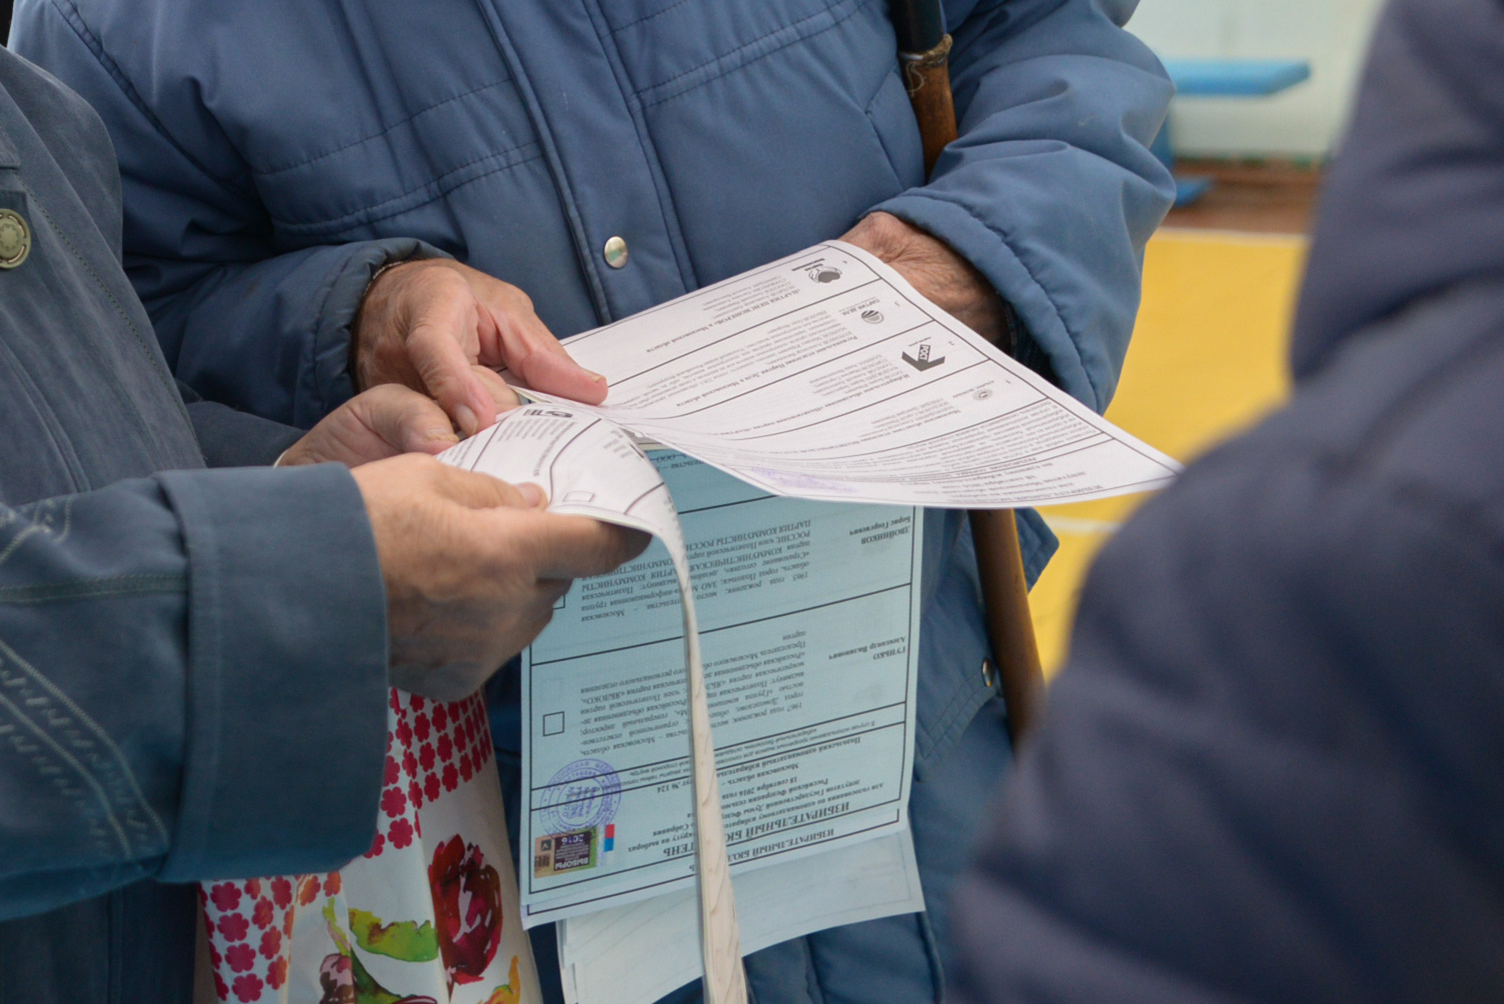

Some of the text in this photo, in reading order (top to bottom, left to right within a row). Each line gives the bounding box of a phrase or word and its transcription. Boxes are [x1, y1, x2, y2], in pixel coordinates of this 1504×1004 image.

[857, 298, 879, 309] ПАРТИЯ
[841, 307, 856, 316] ДЕЛА
[914, 343, 933, 362] РОСТ
[778, 519, 810, 532] ПАРТИЯ
[849, 514, 910, 536] Борис Георгиевич
[715, 525, 776, 545] КОММУНИСТЫ
[758, 537, 773, 546] член
[775, 529, 810, 543] РОССИИ;
[861, 526, 910, 544] ДВОЙНИКОВ
[705, 540, 756, 558] Политической
[786, 539, 809, 550] партия
[689, 546, 782, 571] КОММУНИСТИЧЕСКАЯ
[762, 549, 809, 566] «Страхование
[723, 561, 756, 573] сегодня»,
[758, 565, 778, 576] город
[781, 560, 809, 572] область,
[581, 573, 645, 591] КОММУНИСТЫ
[640, 576, 676, 590] выдвинут:
[720, 571, 756, 585] Подольск;
[769, 576, 784, 585] года
[792, 571, 808, 581] 1965
[700, 580, 717, 589] ЗАО
[725, 580, 761, 594] рождения;
[581, 585, 633, 602] Политическая
[696, 590, 716, 600] место
[581, 599, 606, 611] группа
[581, 608, 624, 623] Московская
[782, 629, 805, 641] партии
[869, 636, 905, 649] Александр
[763, 651, 804, 667] «Российская
[872, 646, 905, 660] ГУНЬКО
[580, 639, 805, 694] Председатель Московского регионального отделения
[713, 660, 761, 677] объединенная
[580, 660, 804, 715] мократическая партия член Политической партии
[627, 683, 650, 695] партия
[720, 679, 766, 696] Политическая
[745, 687, 772, 700] «Группа
[778, 681, 803, 692] ностью
[580, 689, 624, 705] «ЯБЛОКО»,
[784, 690, 803, 701] город
[593, 706, 644, 723] объединенная
[622, 711, 667, 728] генеральный
[732, 708, 767, 722] рождения;
[579, 722, 615, 737] директор;
[629, 718, 678, 736] ограниченной
[809, 727, 849, 741] использования
[580, 732, 622, 747] ответствен-
[613, 735, 654, 751] Московская
[818, 736, 860, 753] Подольский
[579, 744, 609, 758] область,
[761, 746, 816, 767] одномандатный
[727, 761, 798, 785] Московская область
[656, 784, 669, 793] 124
[670, 781, 680, 790] №
[738, 787, 754, 796] 2016
[756, 777, 788, 792] сентября
[788, 777, 828, 794] Российской
[721, 791, 737, 800] года
[748, 788, 786, 803] Федерации
[827, 786, 869, 802] голосования
[652, 778, 859, 837] депутатов Государственной Думы Собрания
[758, 800, 815, 820] одномандатному
[745, 801, 849, 839] ИЗБИРАТЕЛЬНЫЙ
[561, 833, 584, 845] 2016
[628, 839, 658, 853] выборах
[752, 827, 833, 857] ИЗБИРАТЕЛЬНЫЙ
[554, 856, 588, 869] ВЫБОРЫ
